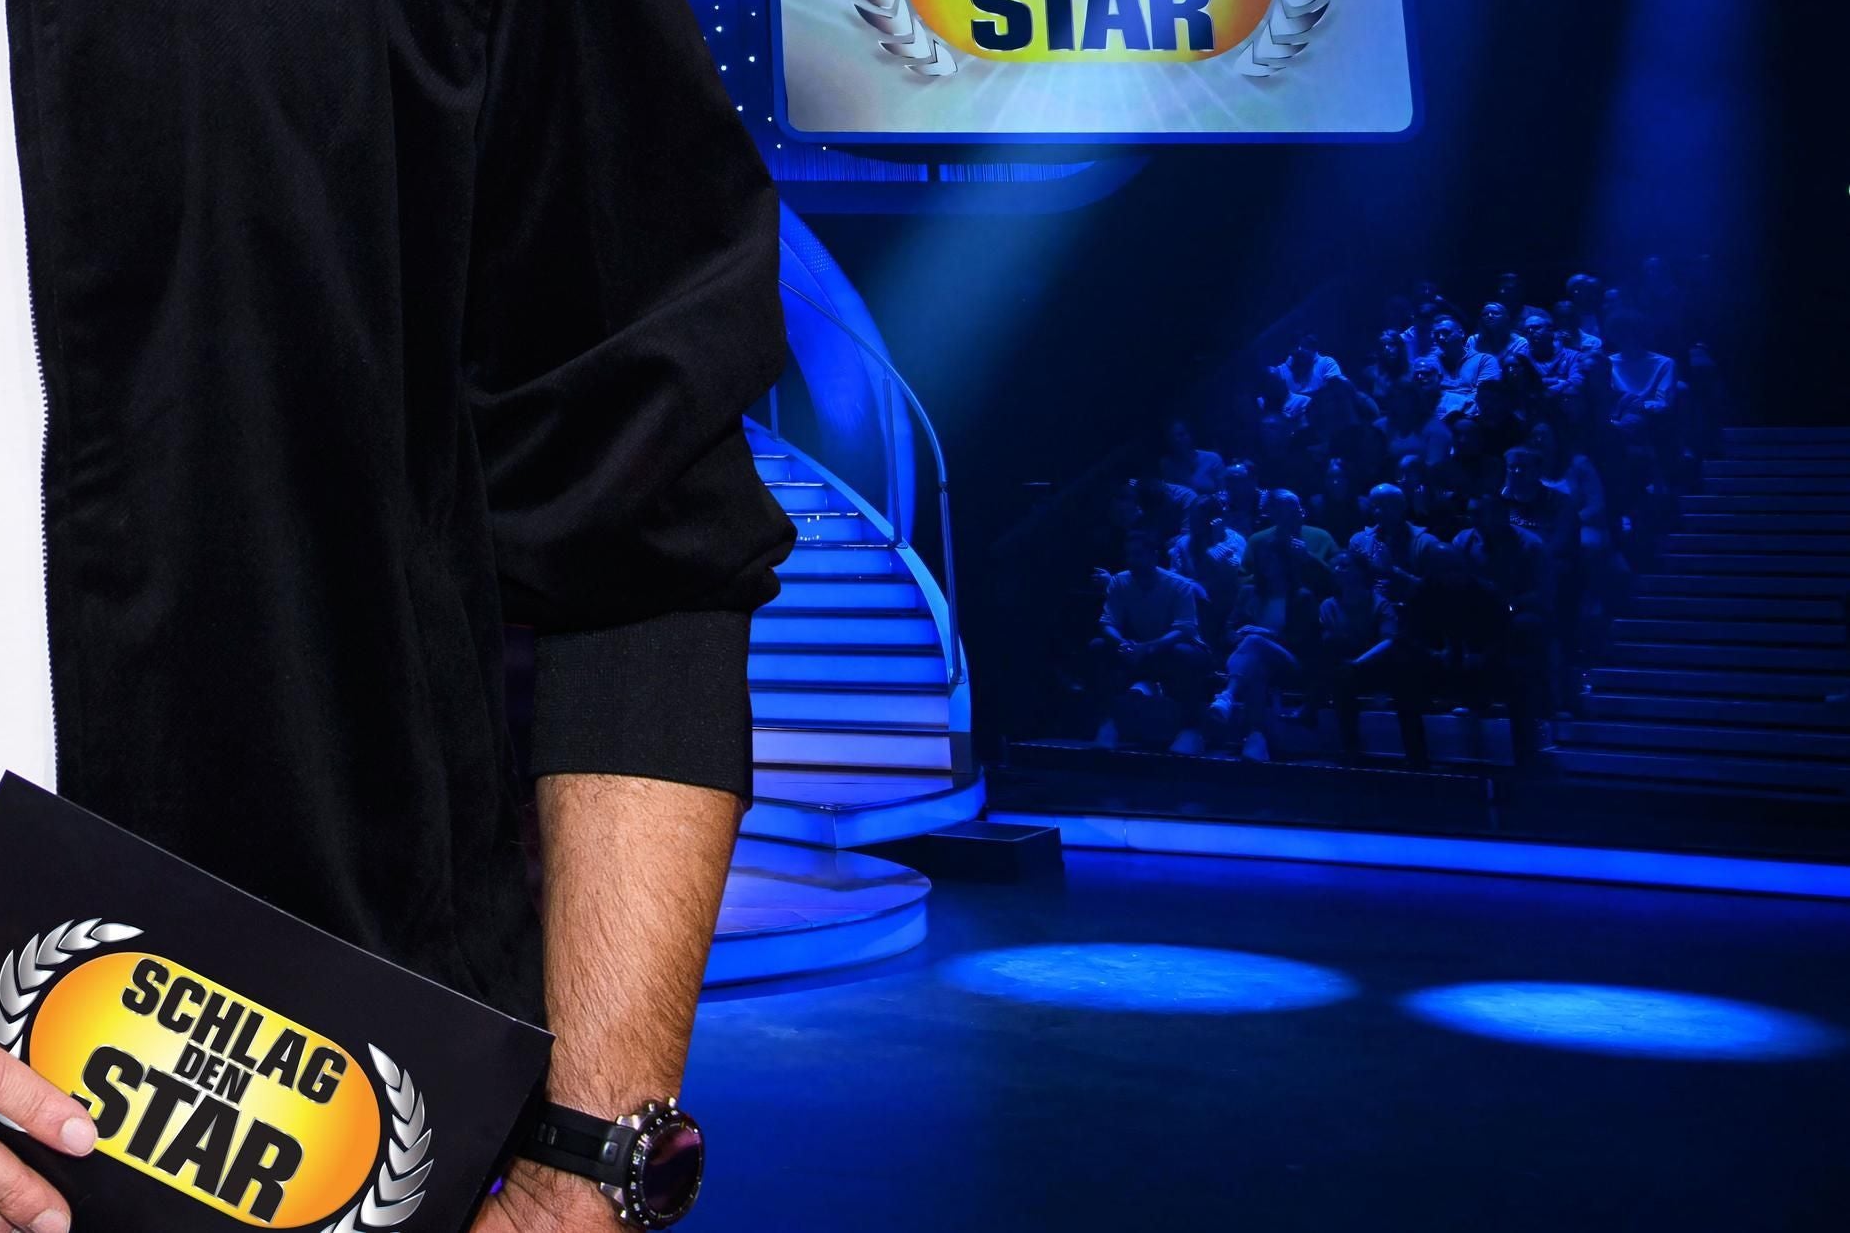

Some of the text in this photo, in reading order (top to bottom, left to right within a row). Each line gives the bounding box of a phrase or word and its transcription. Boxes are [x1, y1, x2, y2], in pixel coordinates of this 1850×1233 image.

[121, 958, 348, 1105] SCHLAG
[174, 1040, 256, 1105] DEN
[72, 1045, 304, 1223] STAR
